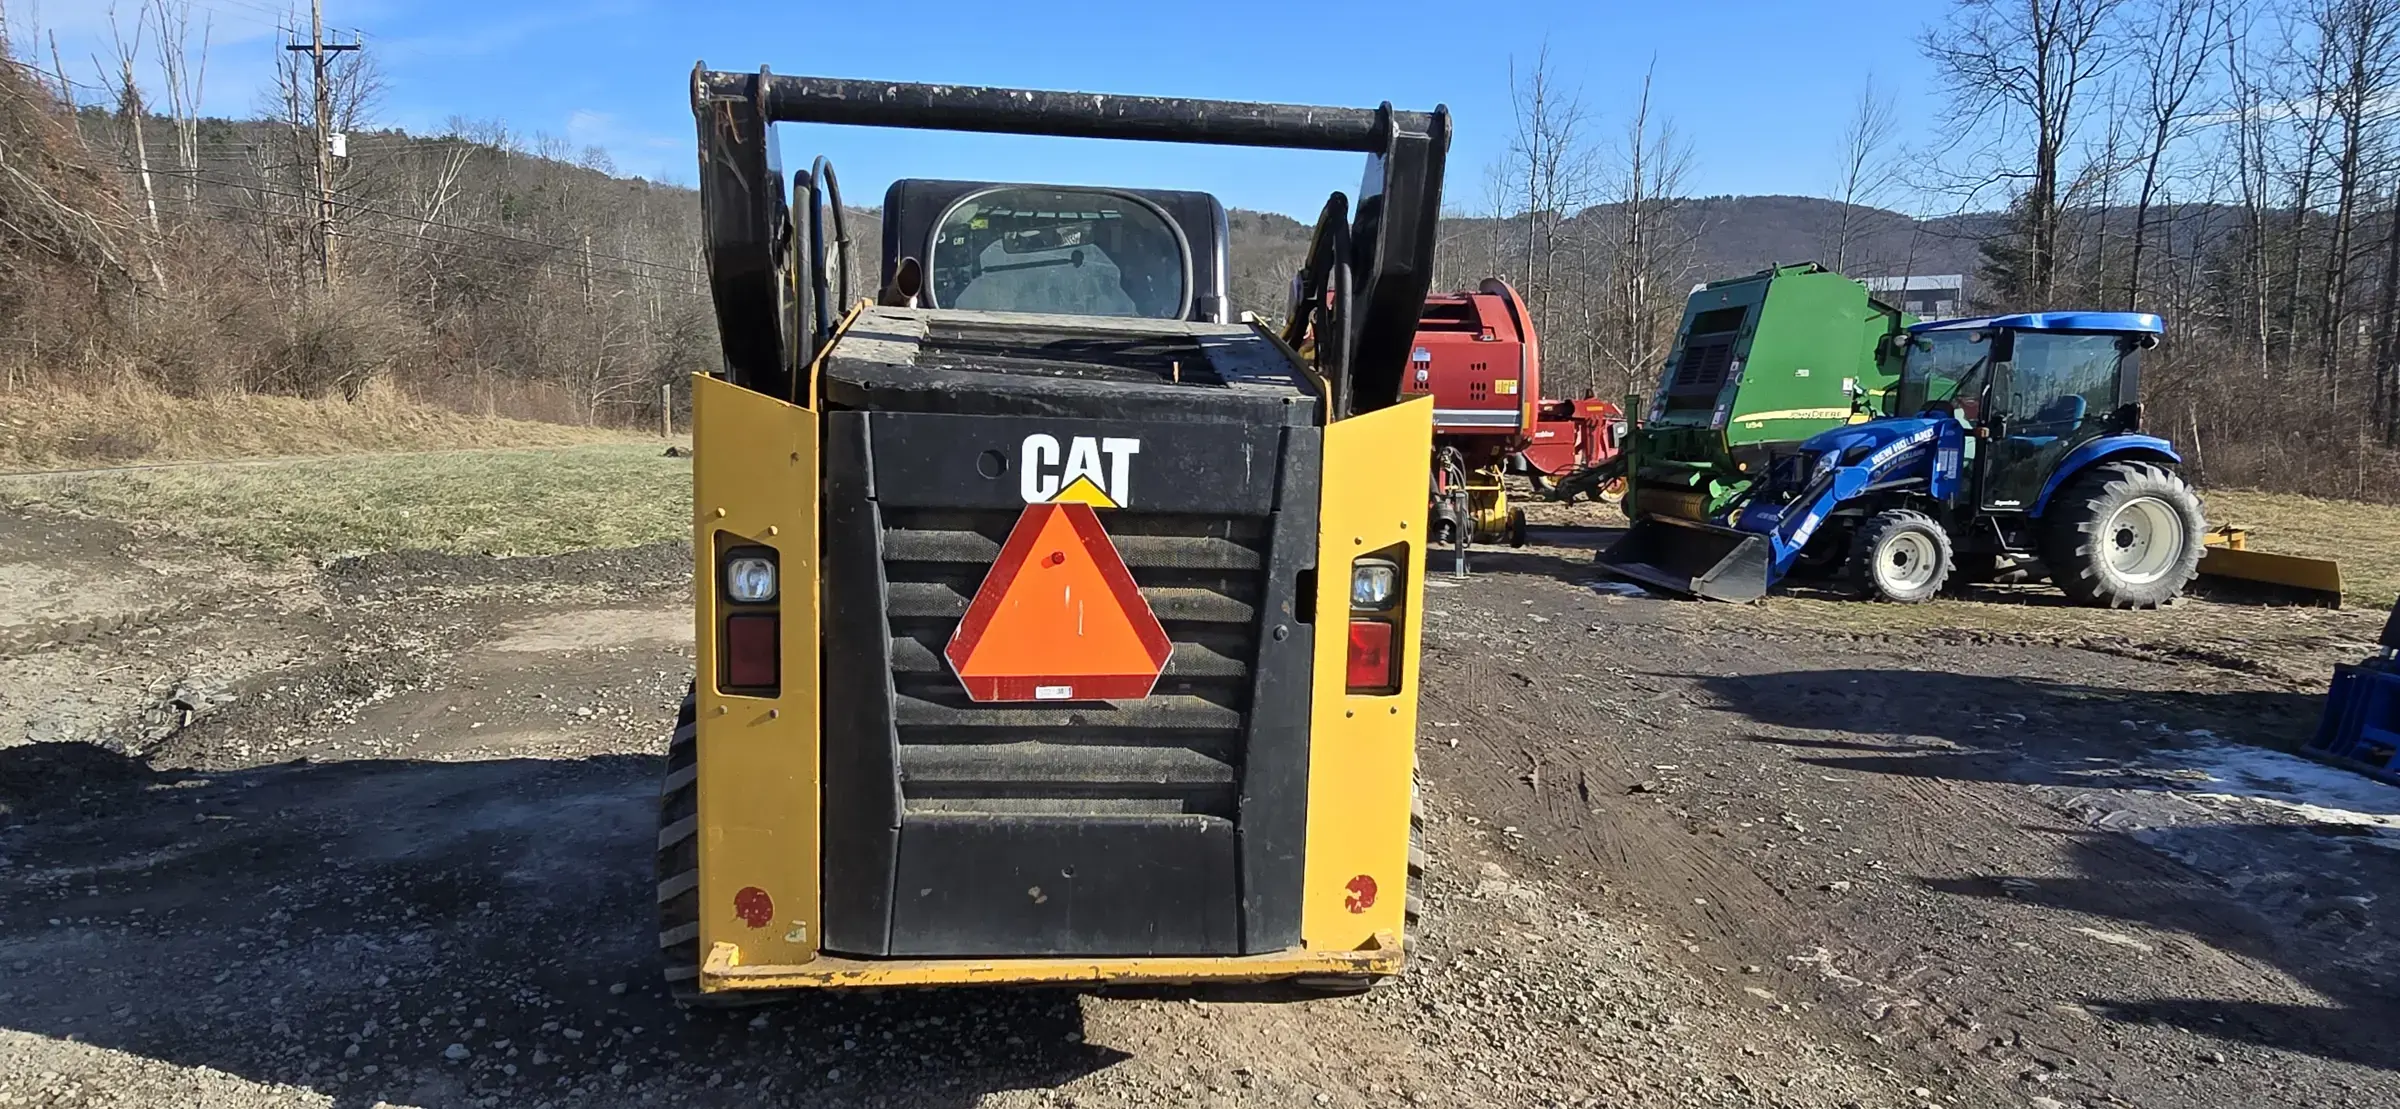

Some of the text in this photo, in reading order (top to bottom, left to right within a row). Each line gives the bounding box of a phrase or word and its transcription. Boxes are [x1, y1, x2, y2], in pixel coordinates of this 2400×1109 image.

[1812, 410, 1842, 418] DEERE
[1871, 445, 1893, 465] NEW
[1892, 427, 1934, 452] HOLLAND
[1021, 433, 1140, 508] CAT
